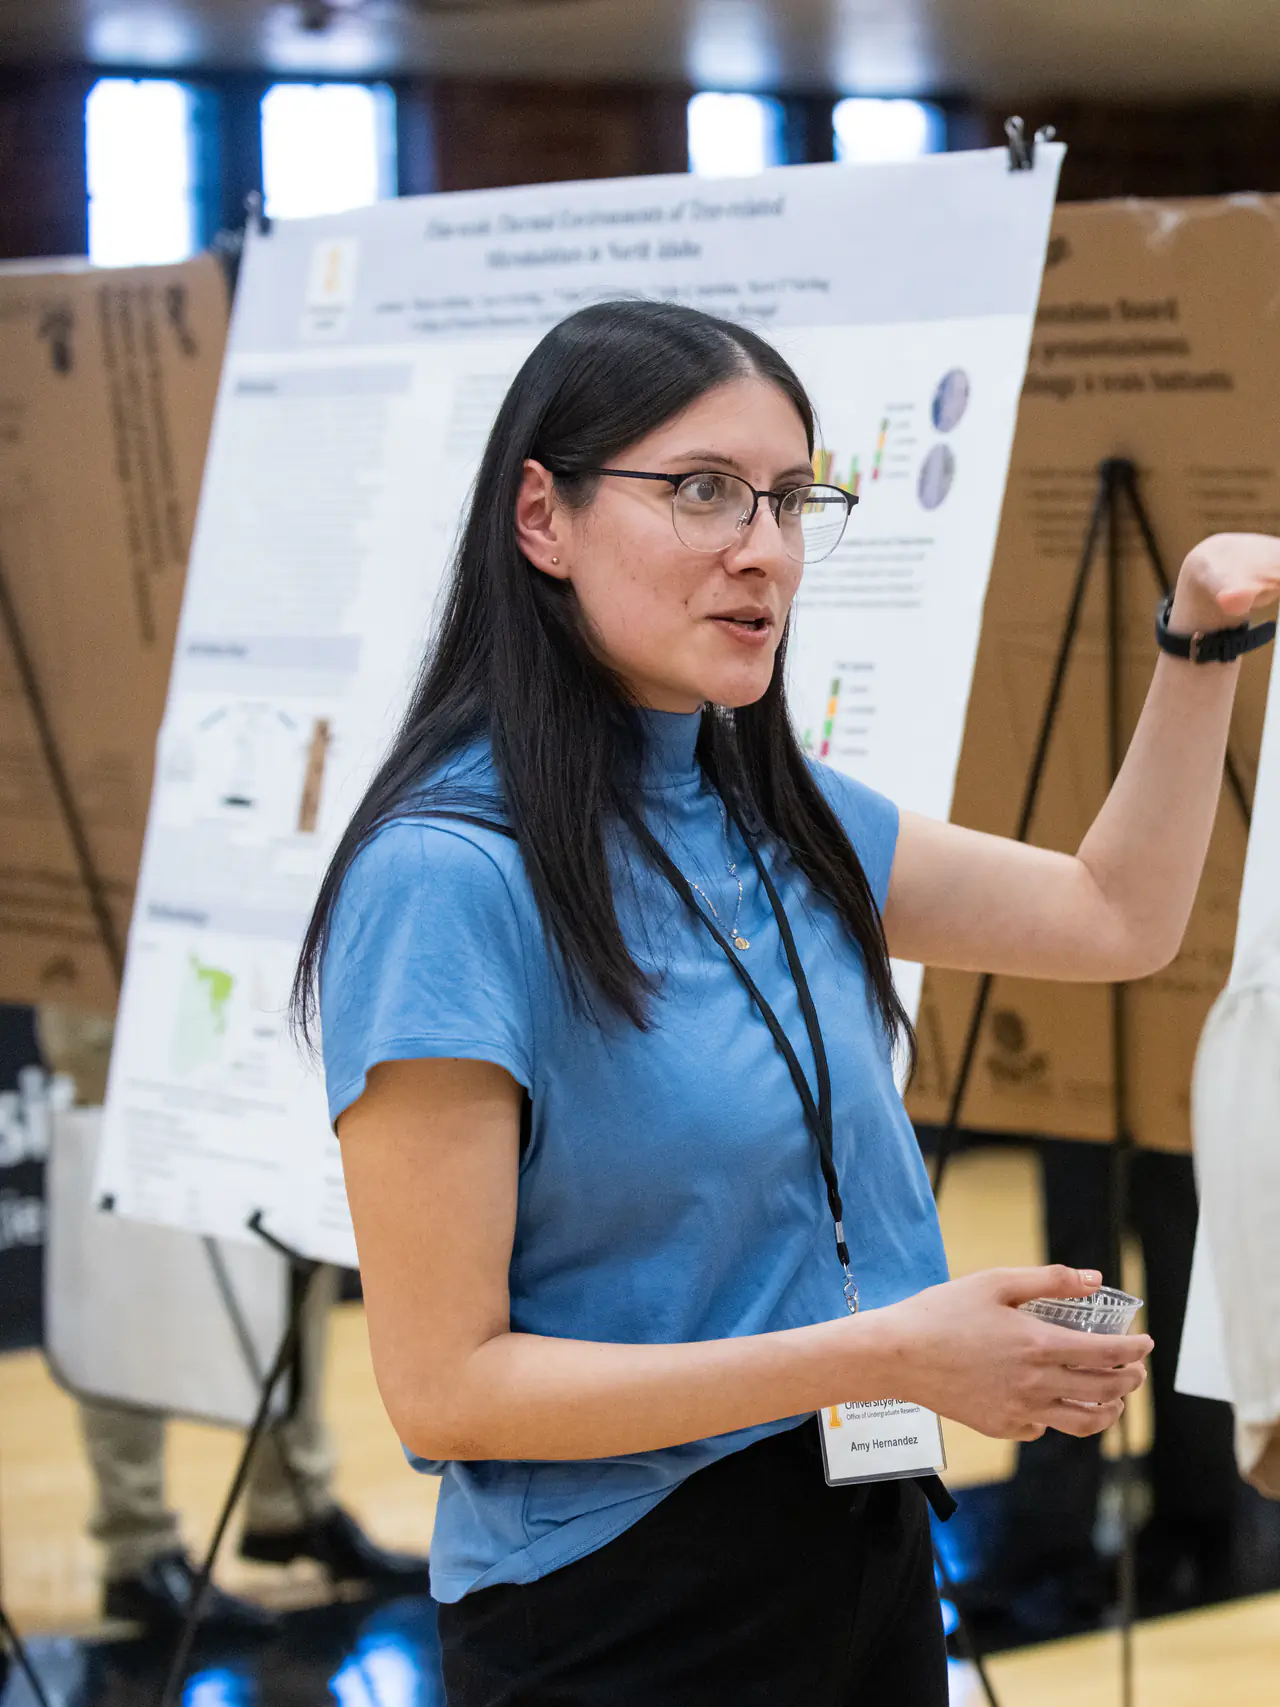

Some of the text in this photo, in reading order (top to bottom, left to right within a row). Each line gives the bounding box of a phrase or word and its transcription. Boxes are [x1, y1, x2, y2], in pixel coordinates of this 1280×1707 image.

[867, 1410, 900, 1418] Undergraduate
[900, 1406, 920, 1414] Research
[850, 1435, 918, 1453] Amy Hernandez
